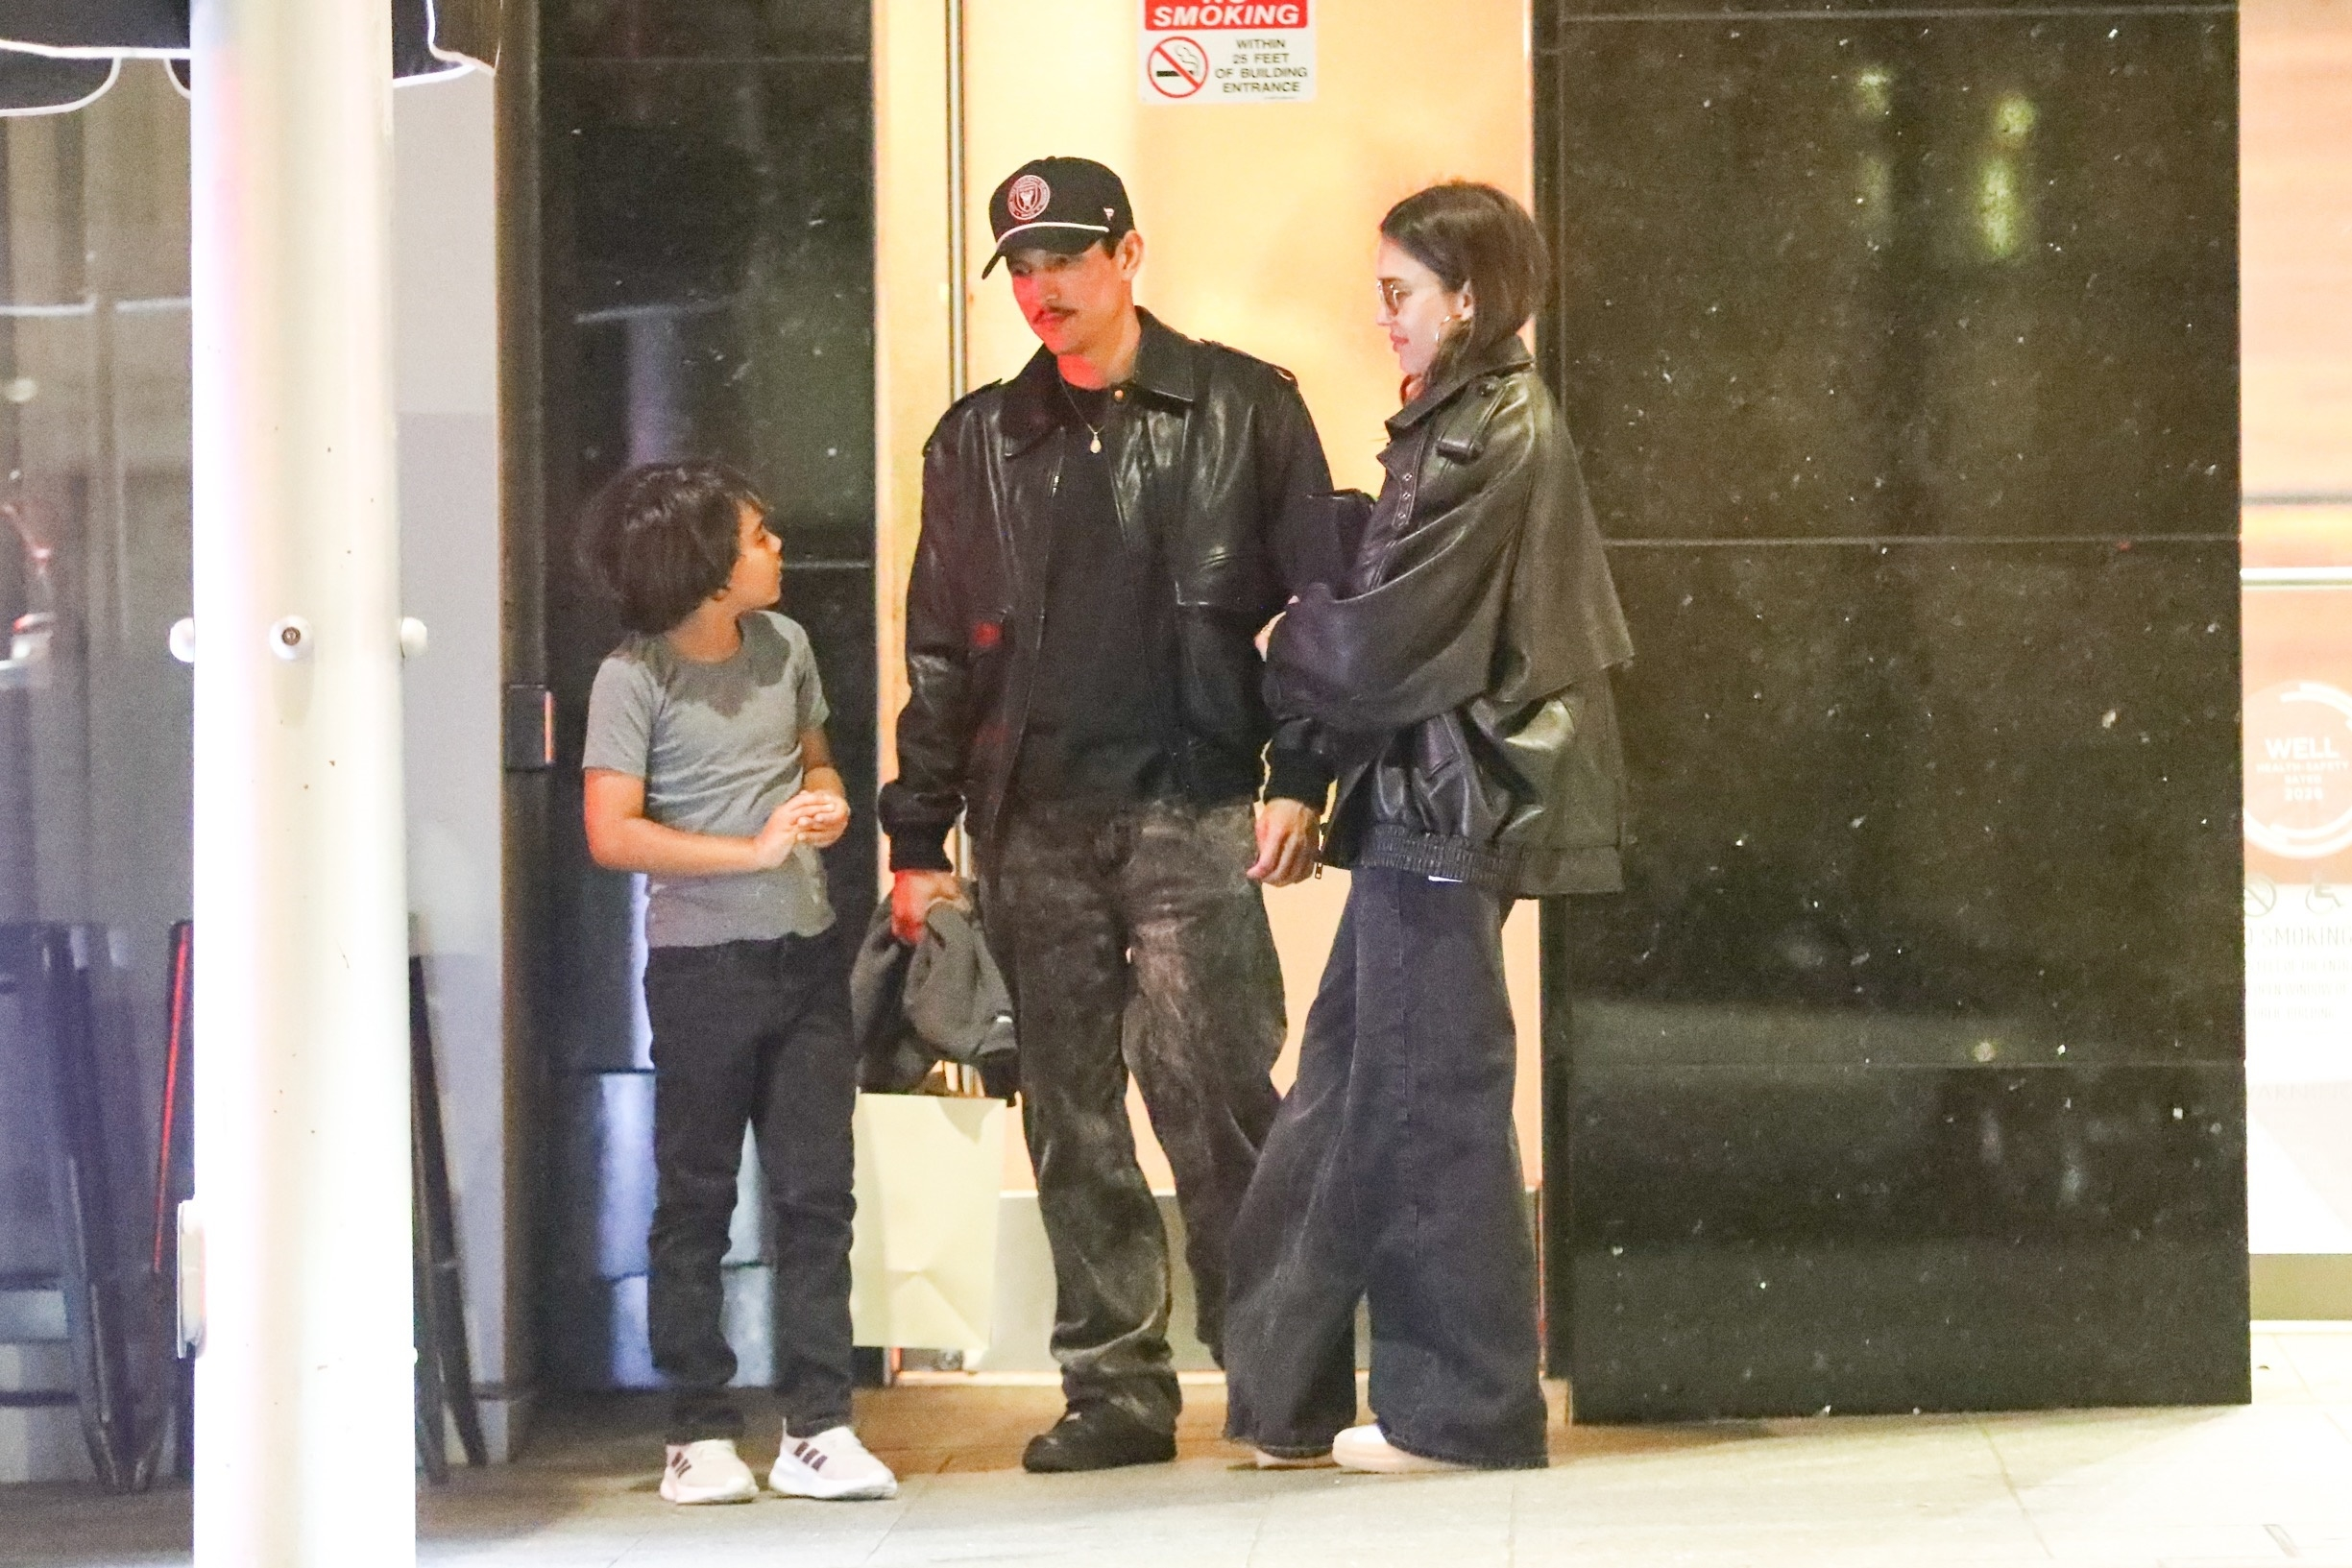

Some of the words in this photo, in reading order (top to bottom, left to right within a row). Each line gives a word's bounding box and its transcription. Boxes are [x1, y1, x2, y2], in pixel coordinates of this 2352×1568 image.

[1152, 4, 1299, 27] SMOKING
[1236, 38, 1286, 49] WITHIN
[1233, 54, 1248, 64] 25
[1254, 53, 1289, 63] FEET
[1215, 68, 1233, 79] OF
[1240, 67, 1307, 79] BUILDING
[1223, 82, 1300, 93] ENTRANCE
[2264, 736, 2340, 760] WELL
